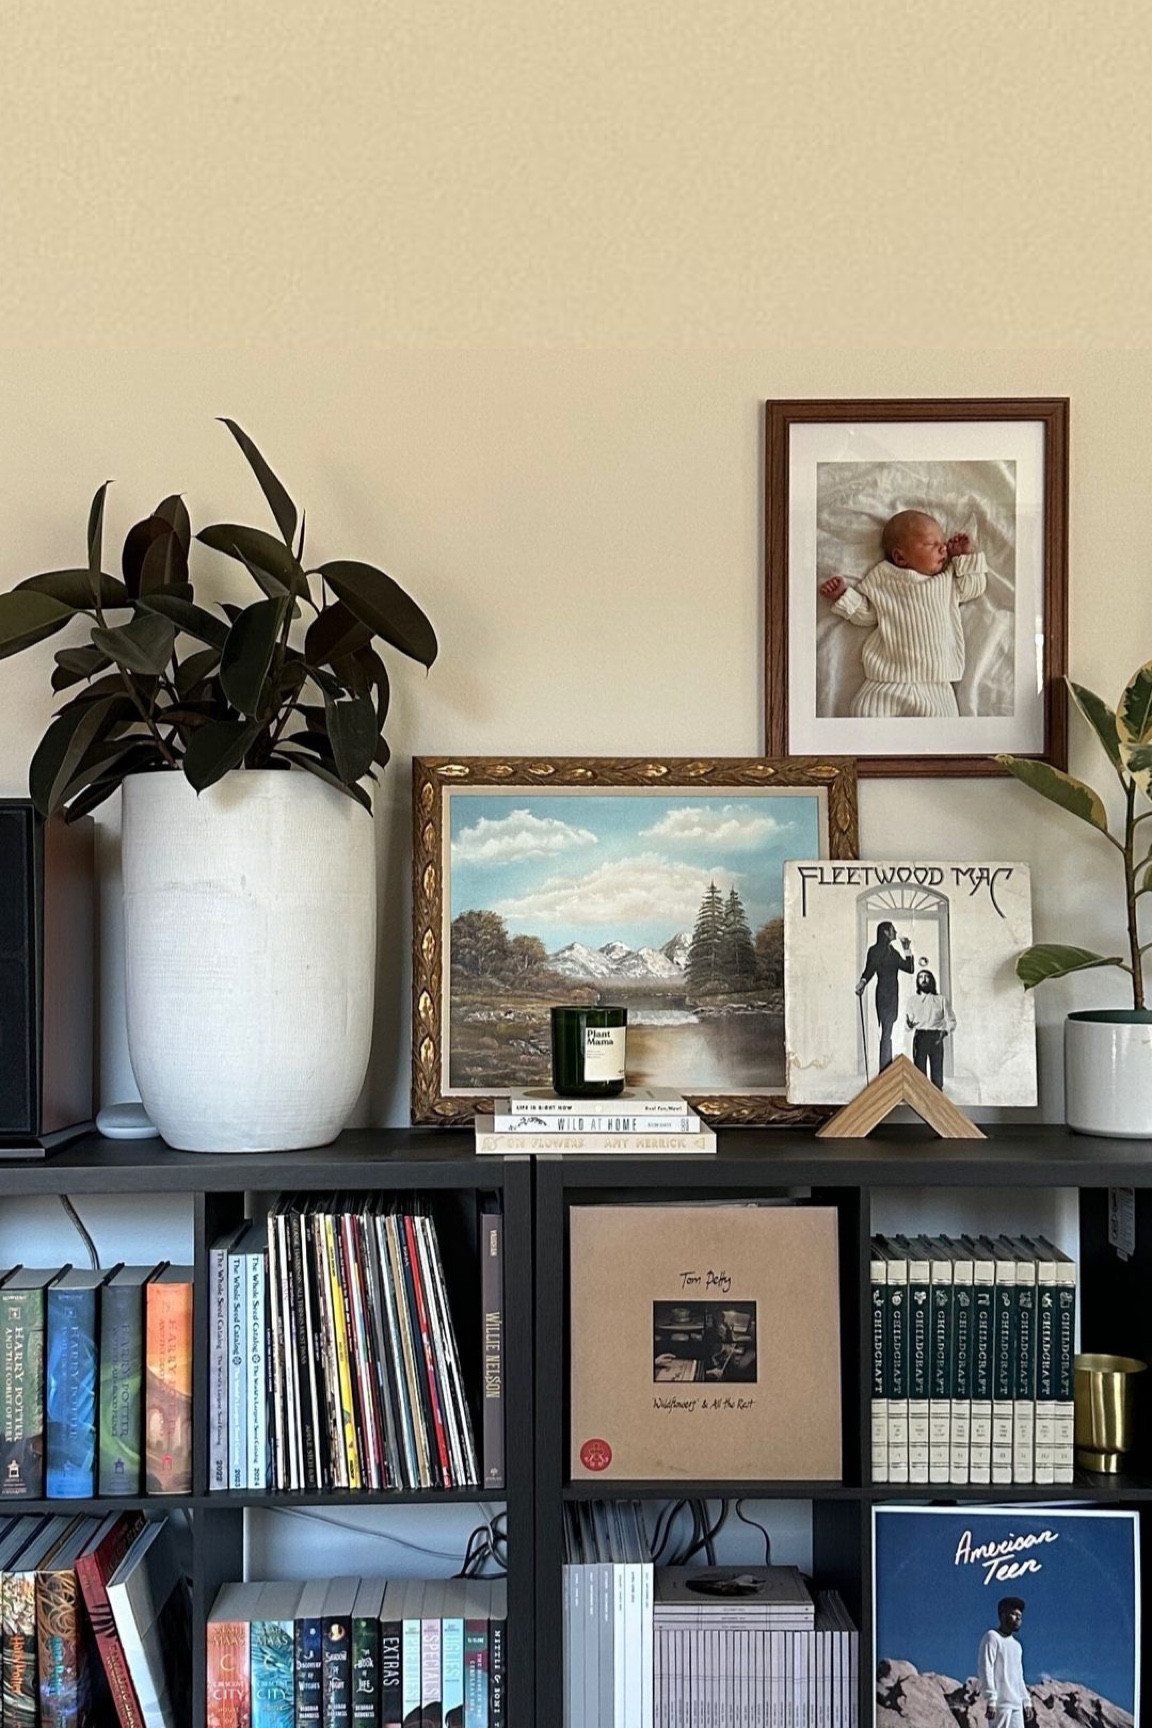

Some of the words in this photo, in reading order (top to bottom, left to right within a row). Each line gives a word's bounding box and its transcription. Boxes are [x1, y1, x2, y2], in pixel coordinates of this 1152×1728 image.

[798, 867, 944, 917] FLEETWOOD
[951, 867, 1013, 918] MAC
[532, 1138, 584, 1148] FLOWERS
[604, 1139, 628, 1148] AMY
[636, 1139, 686, 1148] MERRICK
[558, 1118, 583, 1130] WILD
[591, 1119, 601, 1130] AT
[608, 1119, 636, 1131] HOME
[680, 1271, 701, 1289] Tom
[706, 1270, 731, 1293] Petty
[5, 1328, 13, 1350] AND
[14, 1327, 24, 1381] HARRY
[71, 1326, 79, 1379] HARRY
[121, 1324, 130, 1377] HARRY
[168, 1319, 176, 1375] HARRY
[485, 1312, 502, 1350] WILLIE
[874, 1310, 883, 1393] CHILDCRAFT
[892, 1310, 902, 1394] CHILDCRAFT
[915, 1310, 924, 1394] CHILDCRAFT
[936, 1311, 946, 1394] CHILDCRAFT
[958, 1311, 968, 1394] CHILDCRAFT
[977, 1311, 988, 1394] CHILDCRAFT
[1000, 1311, 1010, 1395] CHILDCRAFT
[1020, 1311, 1029, 1394] CHILDCRAFT
[1041, 1312, 1050, 1395] CHILDCRAFT
[1060, 1312, 1070, 1395] CHILDCRAFT
[484, 1355, 502, 1398] NELSON
[13, 1387, 23, 1442] POTTER
[120, 1384, 129, 1437] POTTER
[702, 1399, 707, 1407] &
[712, 1398, 720, 1408] All
[737, 1398, 754, 1409] Rest
[955, 1531, 1059, 1565] American
[982, 1554, 1042, 1585] Teen
[11, 1636, 25, 1663] Harry
[383, 1637, 400, 1687] EXTRAS
[422, 1634, 440, 1697] SPECIALS
[444, 1633, 461, 1680] UGLIES
[11, 1665, 26, 1694] Potter
[213, 1689, 244, 1700] CITY
[257, 1689, 286, 1700] CITY
[299, 1681, 320, 1691] WITCHES
[356, 1679, 374, 1693] LIFE
[494, 1674, 500, 1684] &
